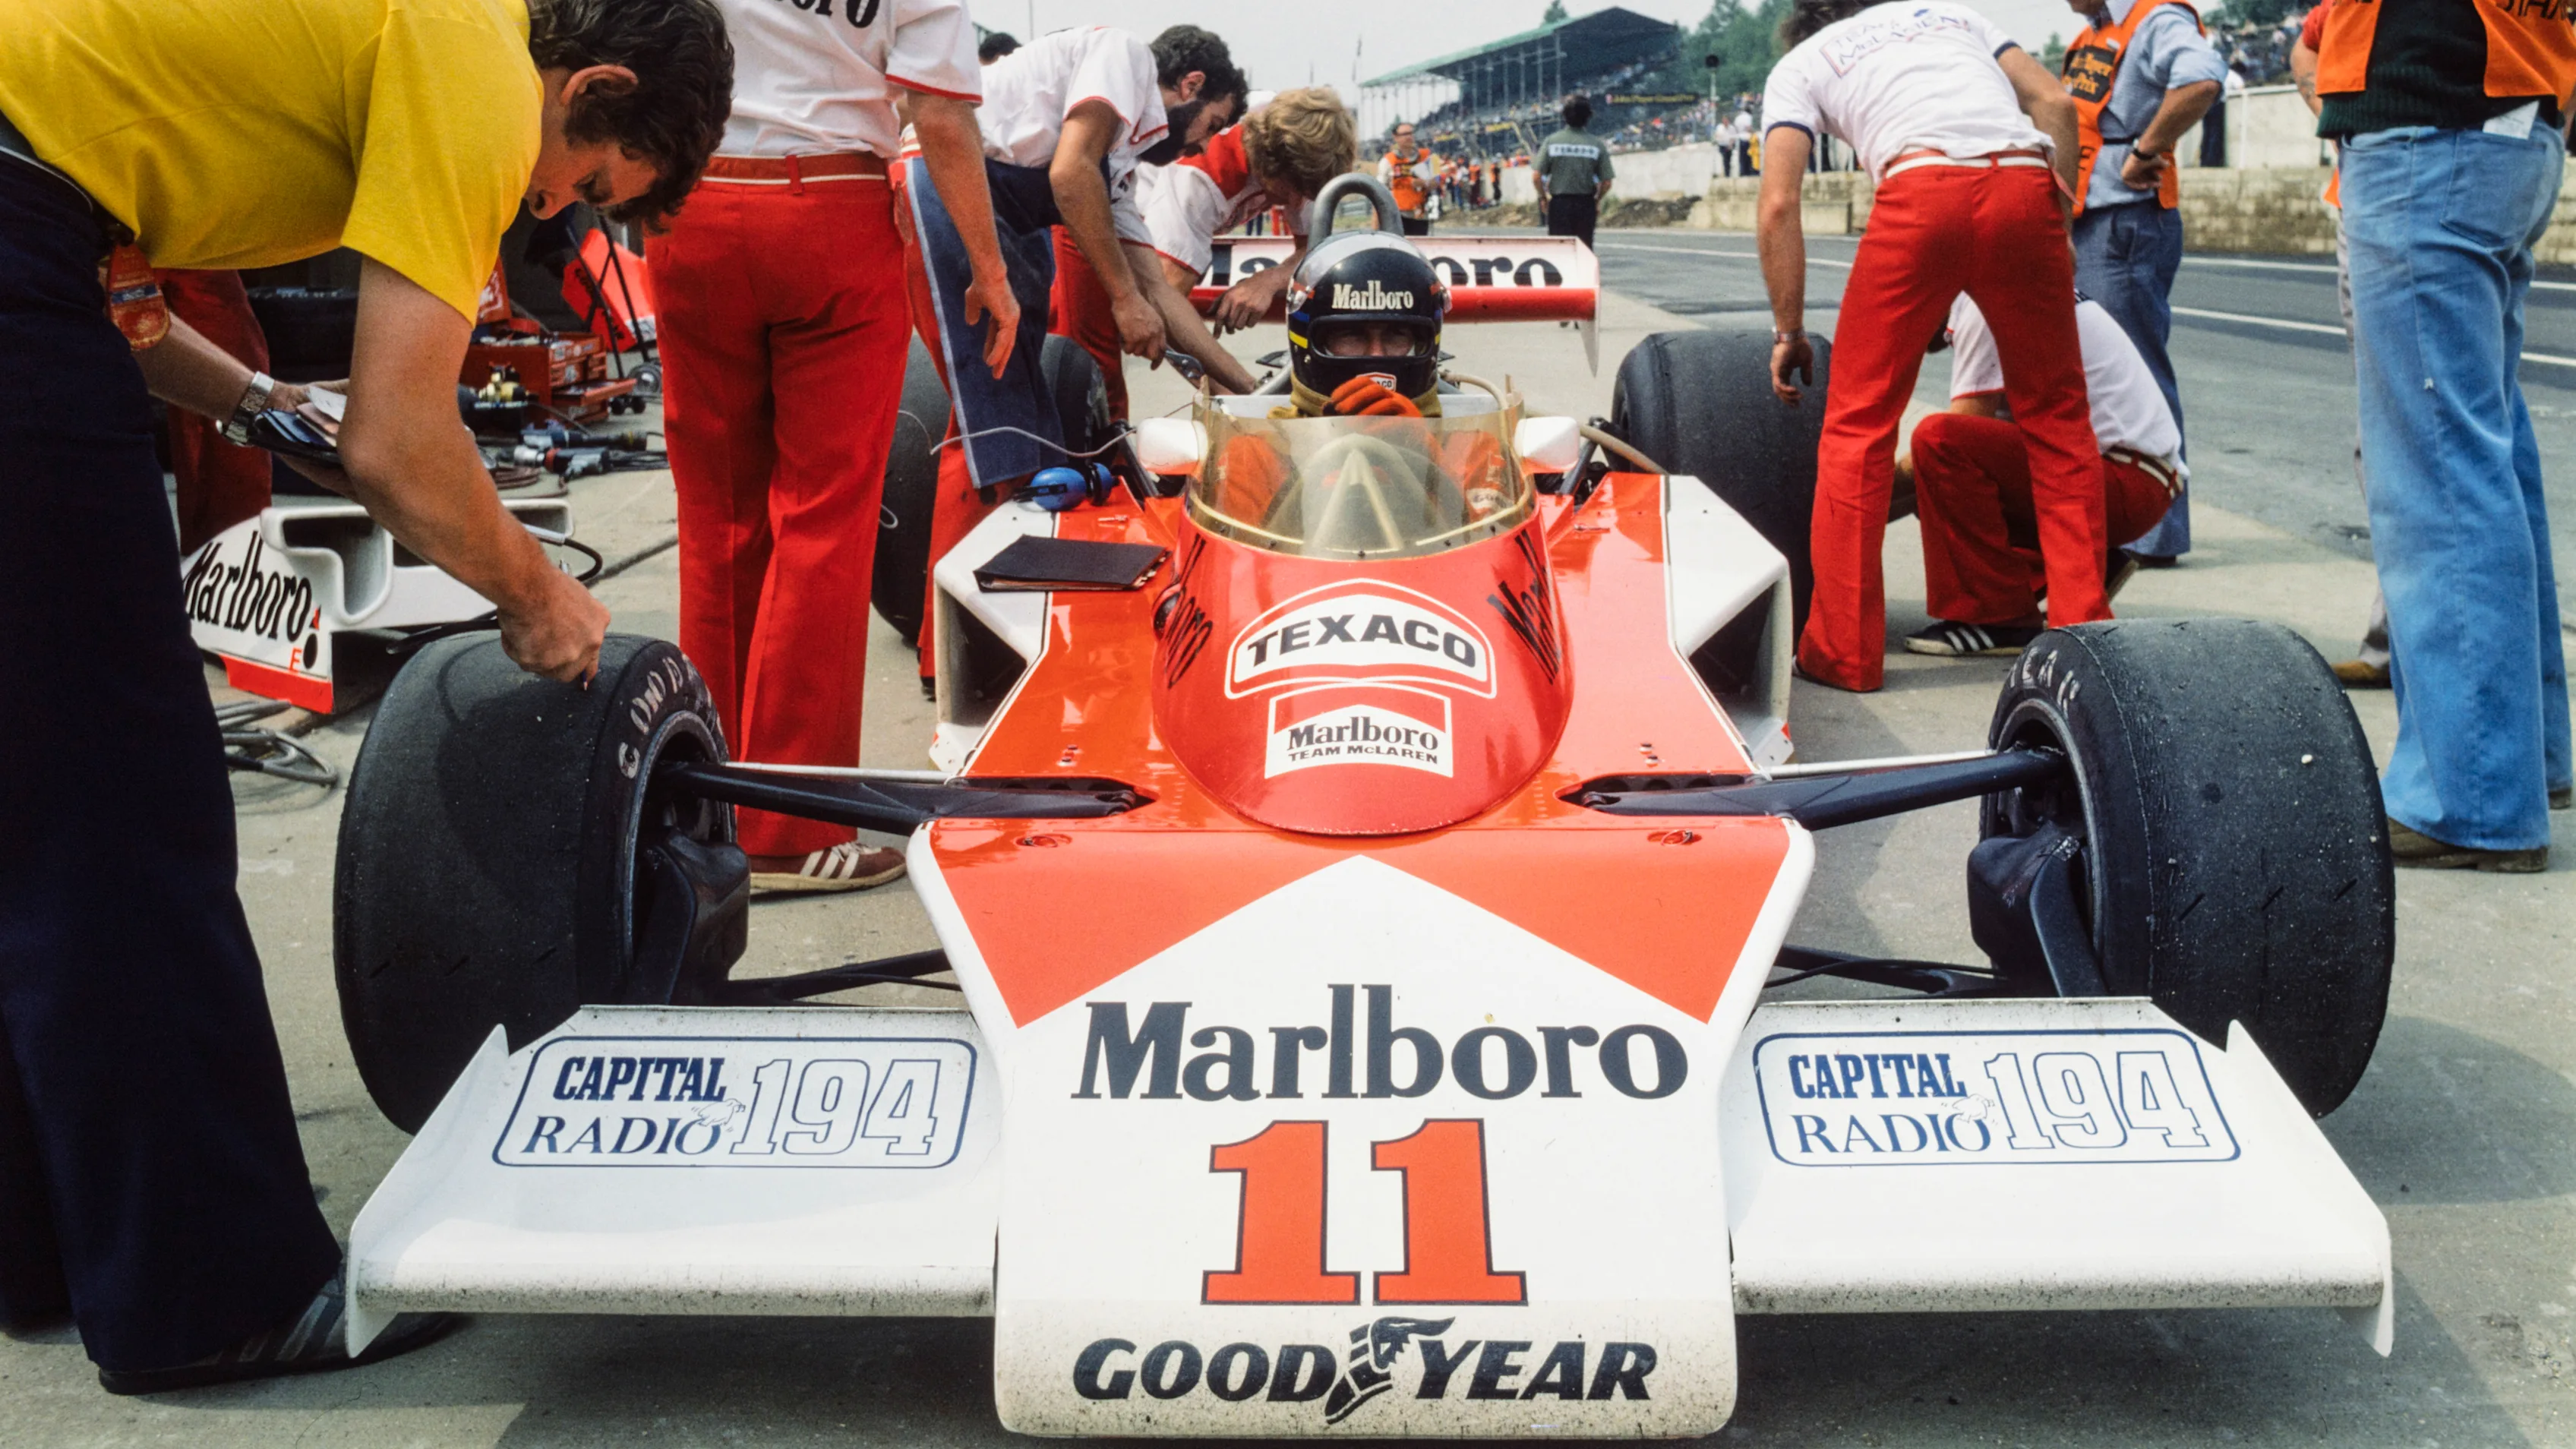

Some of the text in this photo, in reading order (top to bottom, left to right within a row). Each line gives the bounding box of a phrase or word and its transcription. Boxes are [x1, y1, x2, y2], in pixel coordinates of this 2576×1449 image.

[1331, 280, 1414, 311] Marlboro
[184, 530, 312, 642] Marlboro
[1248, 614, 1476, 668] TEXACO
[1286, 716, 1438, 751] Marlboro
[1288, 745, 1438, 765] TEAM McLAREN
[1071, 983, 1689, 1102] Marlboro
[552, 1056, 727, 1102] CAPITAL
[1788, 1053, 1968, 1099] CAPITAL
[1983, 1051, 2211, 1151] 194
[728, 1059, 942, 1155] 194
[519, 1115, 722, 1155] RADIO
[1791, 1112, 1993, 1154] RADIO
[1200, 1118, 1529, 1306] 11
[1072, 1337, 1659, 1403] GOOD YEAR
